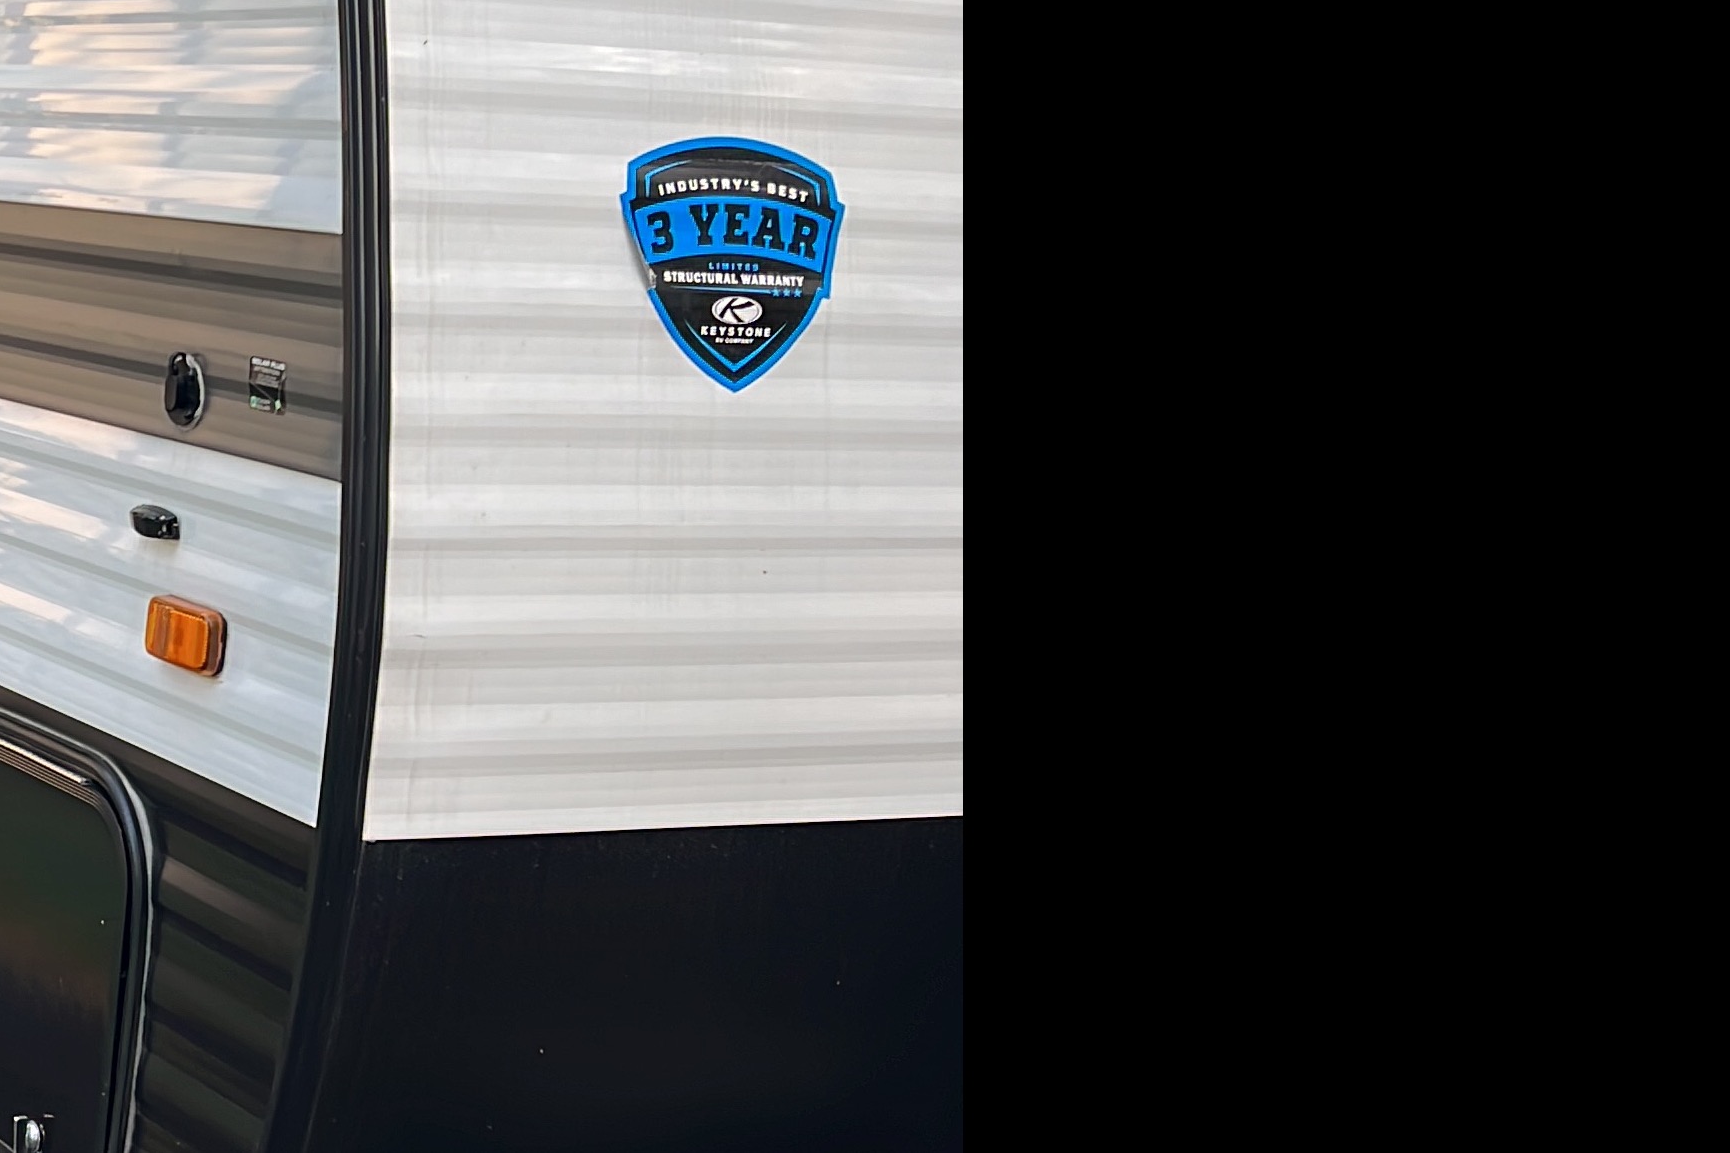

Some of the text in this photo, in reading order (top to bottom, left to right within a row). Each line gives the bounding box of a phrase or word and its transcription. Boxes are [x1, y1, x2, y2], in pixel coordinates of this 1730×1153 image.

[657, 178, 809, 203] INDUSTRY'S BEST
[647, 203, 819, 260] 3 YEAR
[708, 262, 759, 272] LIMITED
[663, 270, 805, 287] STRUCTURAL WARRANTY
[700, 325, 772, 338] KEYSTONE
